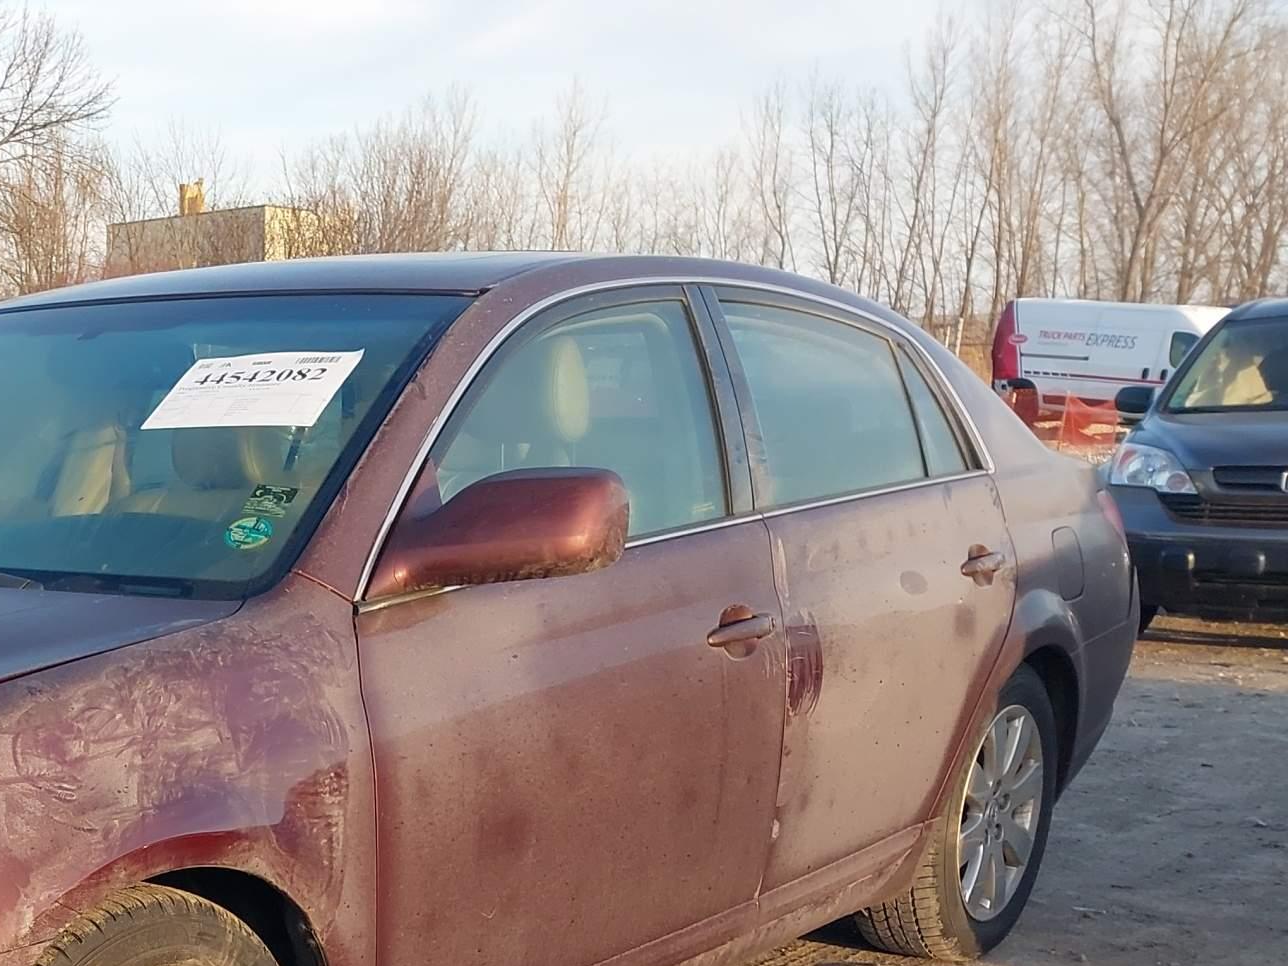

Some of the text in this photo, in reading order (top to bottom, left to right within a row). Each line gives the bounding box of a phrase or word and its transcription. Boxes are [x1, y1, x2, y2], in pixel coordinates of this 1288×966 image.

[1039, 330, 1062, 341] TRUCK
[1063, 331, 1086, 342] PARTS
[1086, 333, 1138, 349] EXPRESS
[195, 367, 328, 385] 44542082
